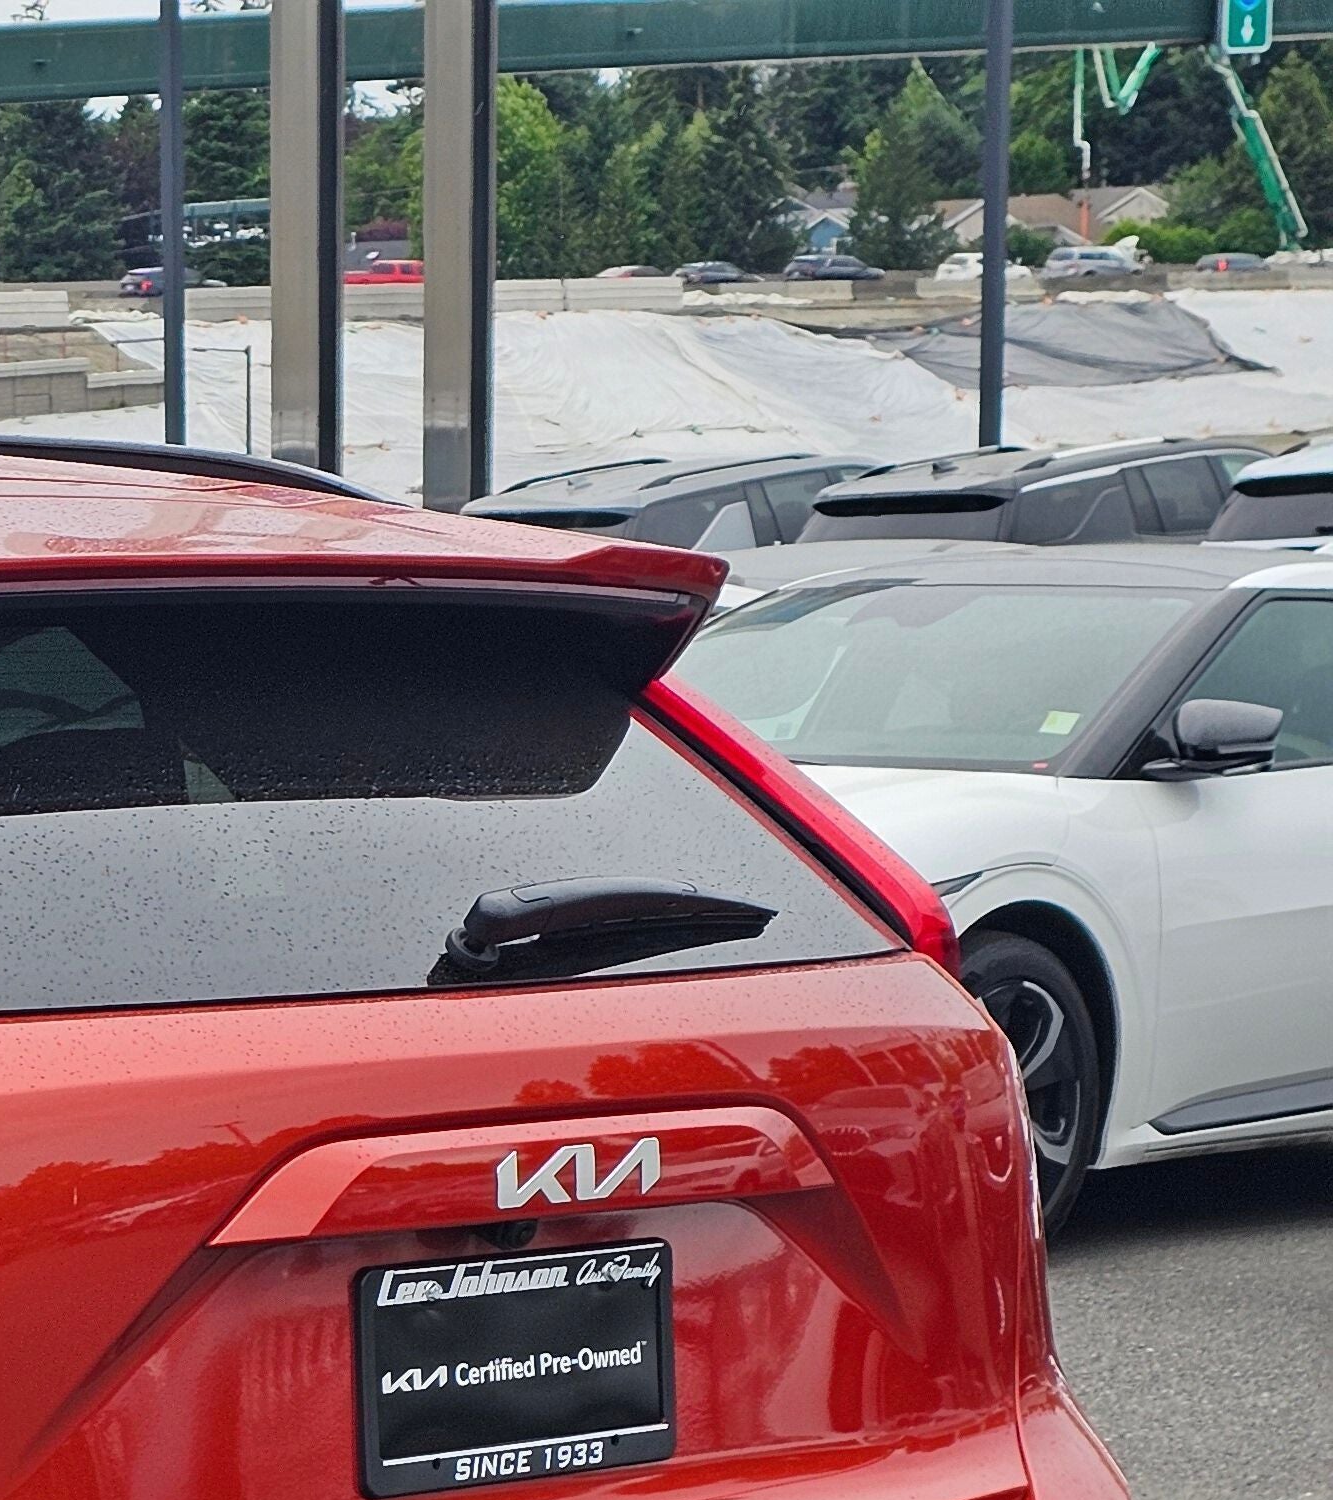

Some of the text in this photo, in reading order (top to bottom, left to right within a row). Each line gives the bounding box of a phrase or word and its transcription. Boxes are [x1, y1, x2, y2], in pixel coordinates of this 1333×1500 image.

[496, 1137, 660, 1209] KIA
[439, 1261, 569, 1300] Johnson
[382, 1341, 642, 1394] KIA Certified Pre-Owned
[455, 1441, 604, 1481] SINCE 1933
